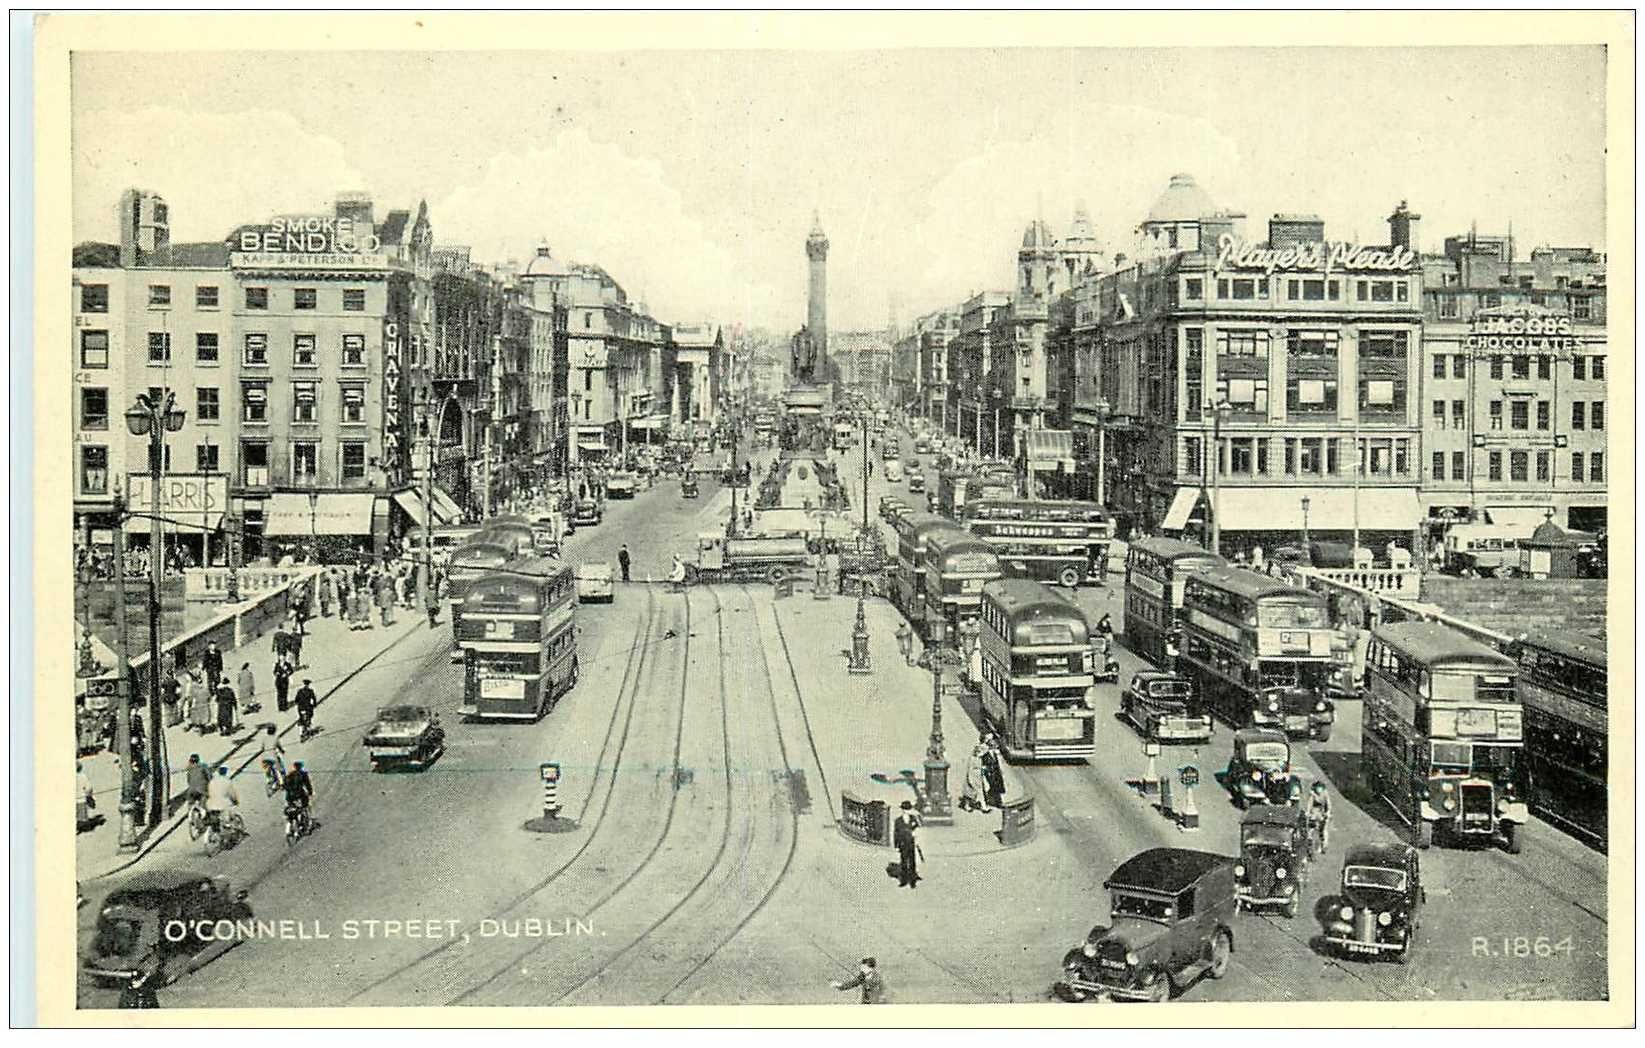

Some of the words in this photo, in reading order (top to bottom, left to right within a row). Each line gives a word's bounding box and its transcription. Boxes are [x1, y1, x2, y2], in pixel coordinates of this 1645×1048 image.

[272, 217, 352, 233] SMOKE
[241, 232, 380, 252] BENDIGO
[288, 255, 354, 265] PETERSON
[1326, 241, 1413, 275] Please
[1466, 336, 1584, 350] CHOCOLATES
[386, 323, 399, 426] CRAVEN
